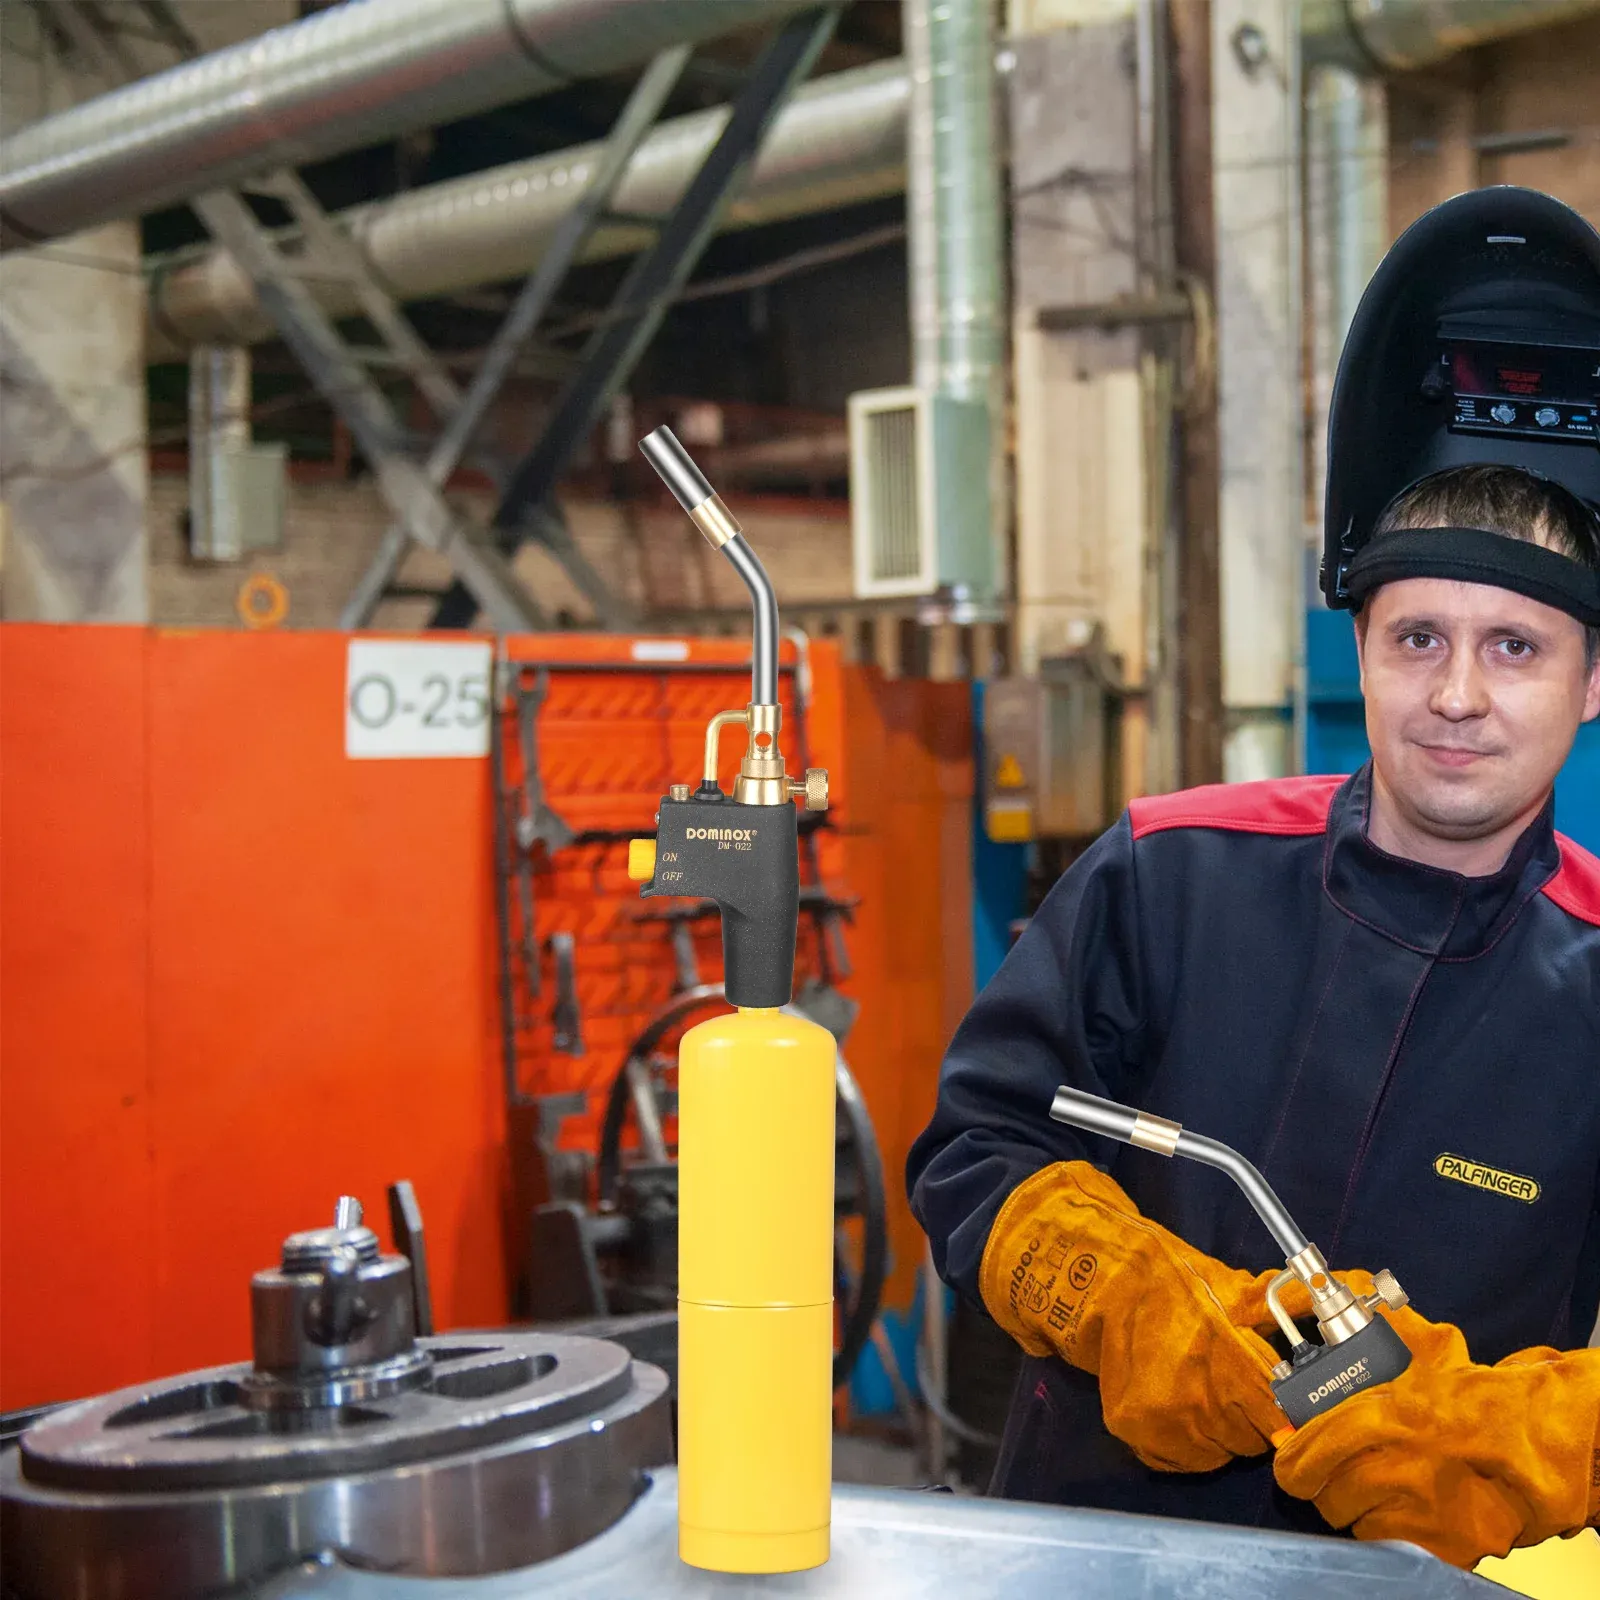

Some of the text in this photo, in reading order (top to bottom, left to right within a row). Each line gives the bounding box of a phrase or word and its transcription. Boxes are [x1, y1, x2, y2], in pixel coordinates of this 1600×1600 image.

[350, 673, 490, 730] O-25
[662, 852, 678, 862] ON
[662, 871, 684, 881] OFF
[1440, 1158, 1533, 1198] PALFINGER
[1074, 1259, 1093, 1282] 10
[1341, 1371, 1372, 1394] DM-022
